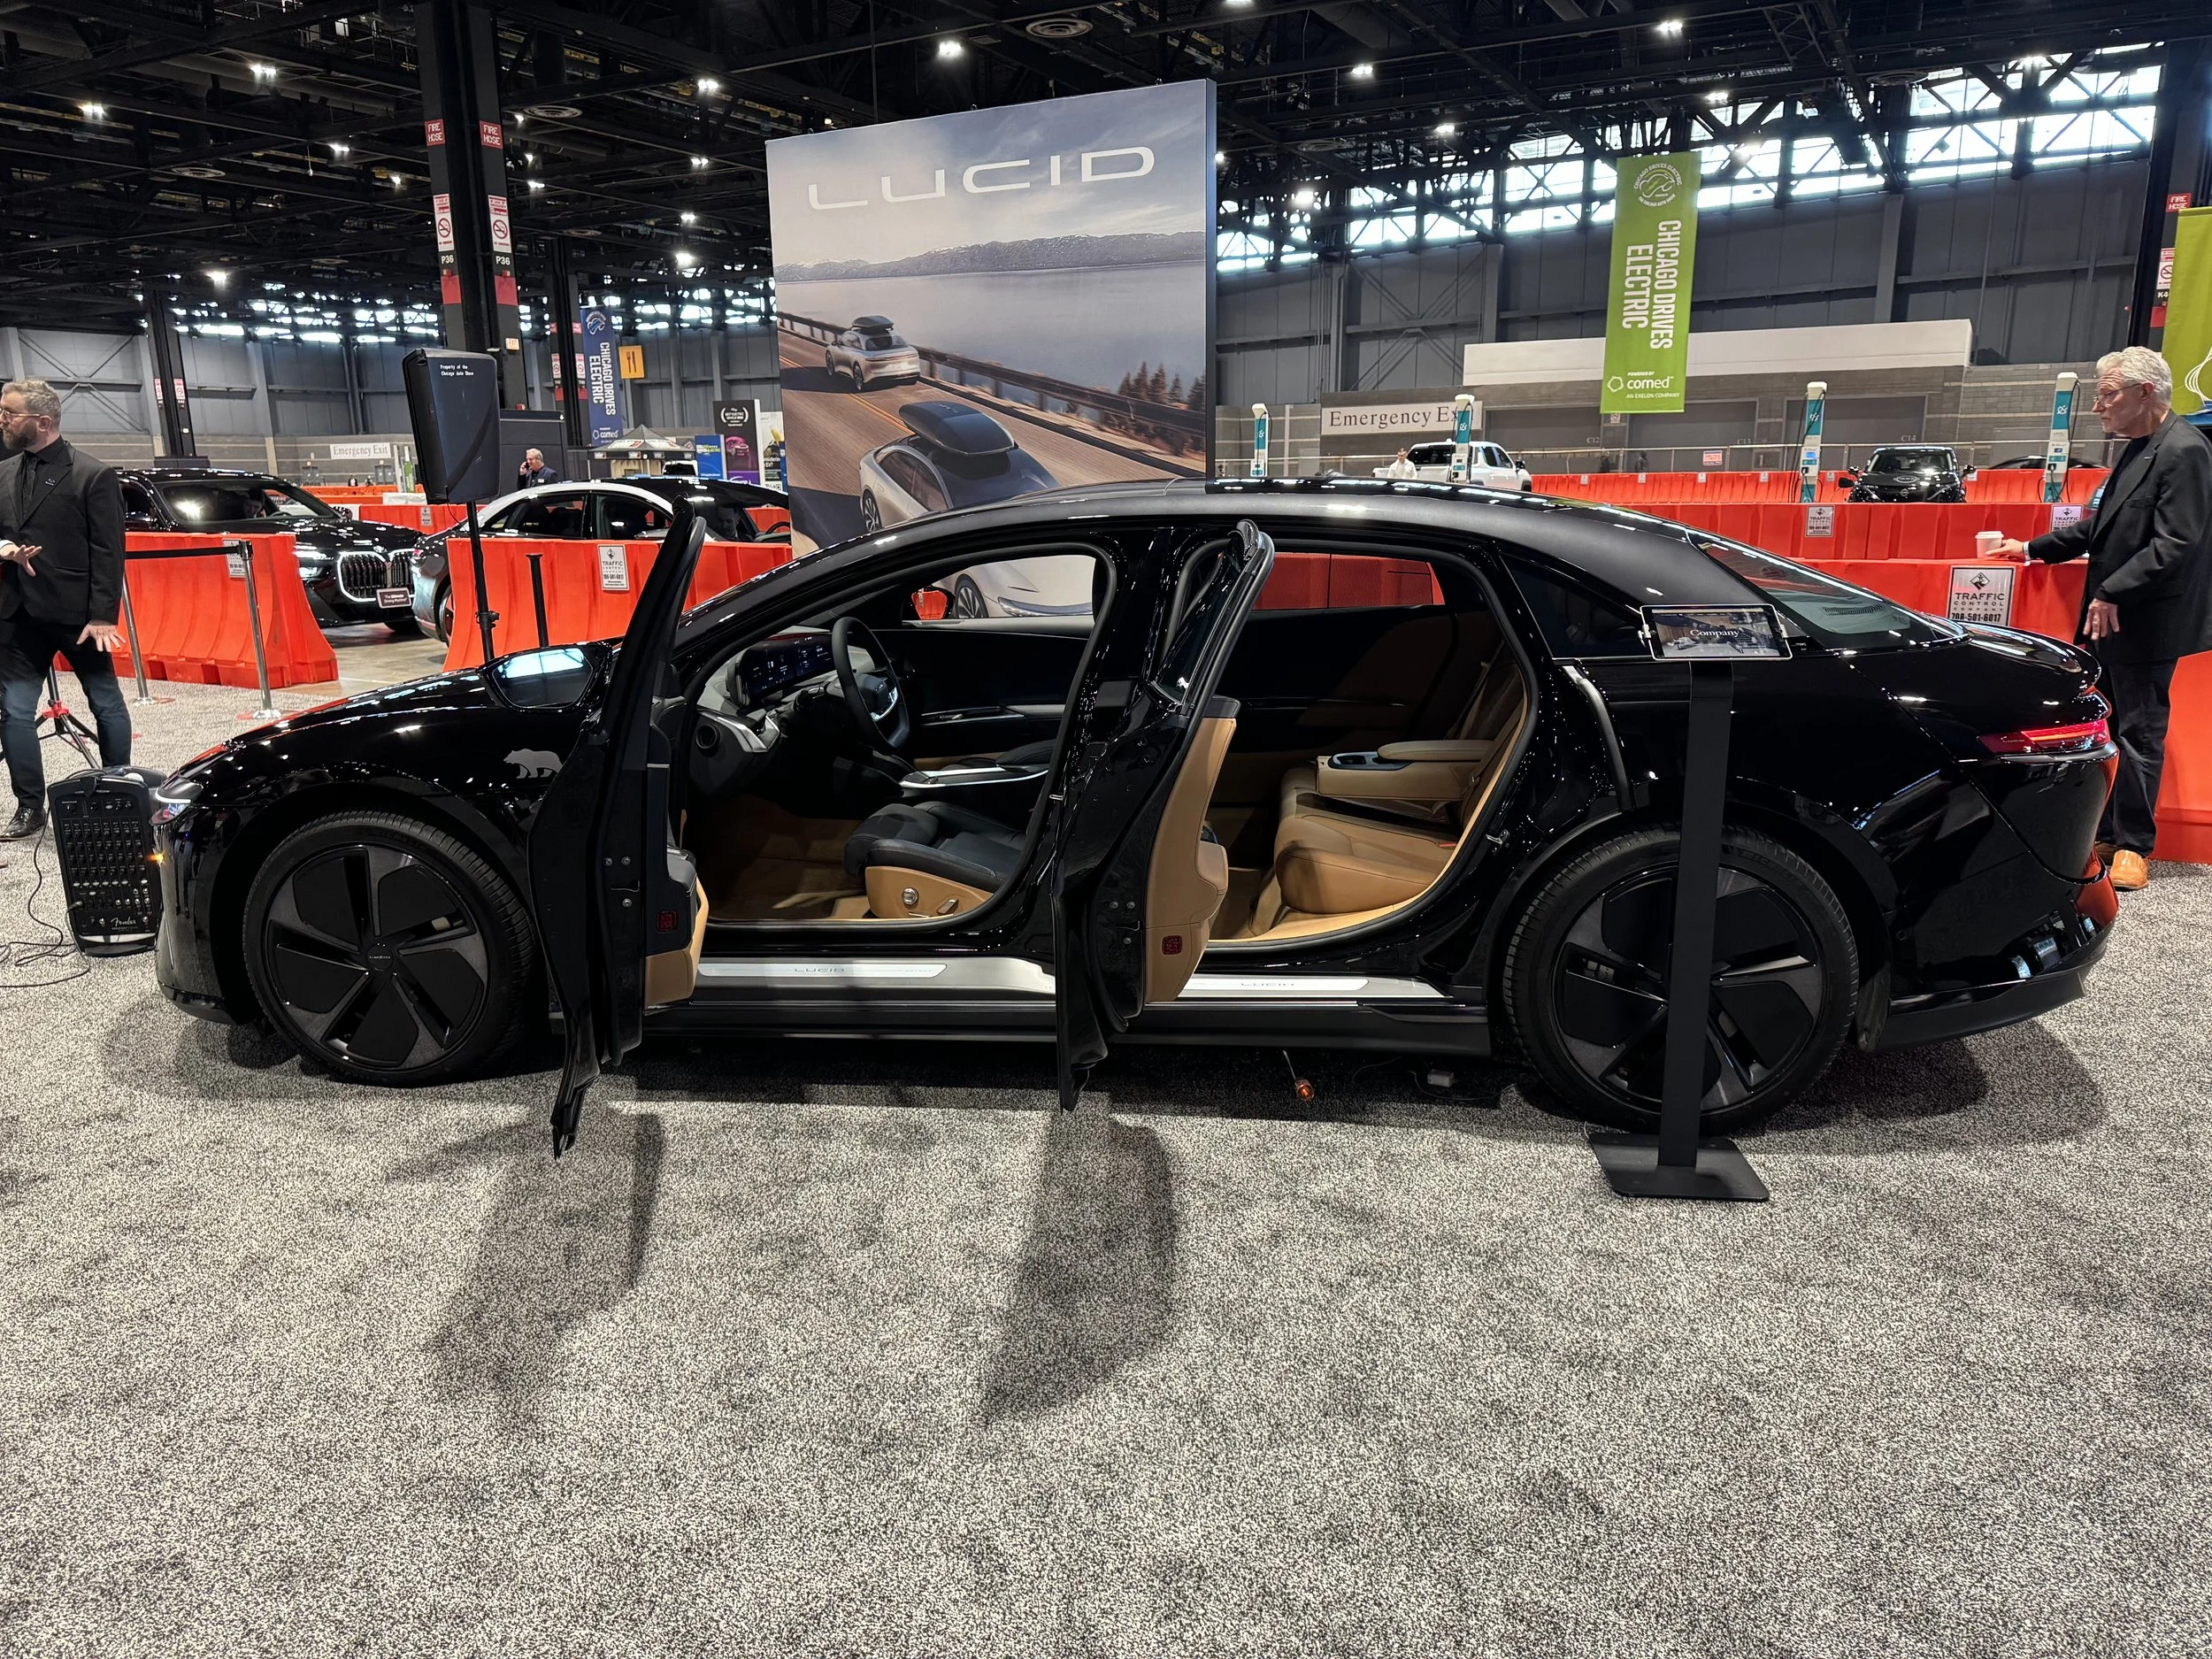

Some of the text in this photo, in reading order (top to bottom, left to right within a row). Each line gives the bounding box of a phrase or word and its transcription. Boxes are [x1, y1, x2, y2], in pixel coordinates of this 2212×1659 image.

[427, 122, 442, 132] FIRE
[483, 125, 498, 135] FIRE
[428, 132, 443, 142] HOSE
[483, 135, 501, 145] HOSE
[808, 146, 1156, 211] LUCID
[441, 254, 454, 264] P36
[1654, 219, 1681, 289] CHICAGO
[495, 256, 511, 265] P36
[1622, 243, 1654, 329] ELECTRIC
[1649, 293, 1676, 349] DRIVES
[600, 342, 613, 384] CHICAGO
[589, 355, 604, 403] ELECTRIC
[1627, 376, 1671, 390] comed
[603, 384, 616, 416] DRIVES
[1330, 406, 1459, 429] Emergency Ex
[333, 444, 388, 457] Emergency Exit
[1955, 592, 2005, 601] TRAFFIC
[1951, 612, 2001, 622] 708-501-6017
[1690, 629, 1740, 638] Company
[110, 916, 136, 927] Fender
